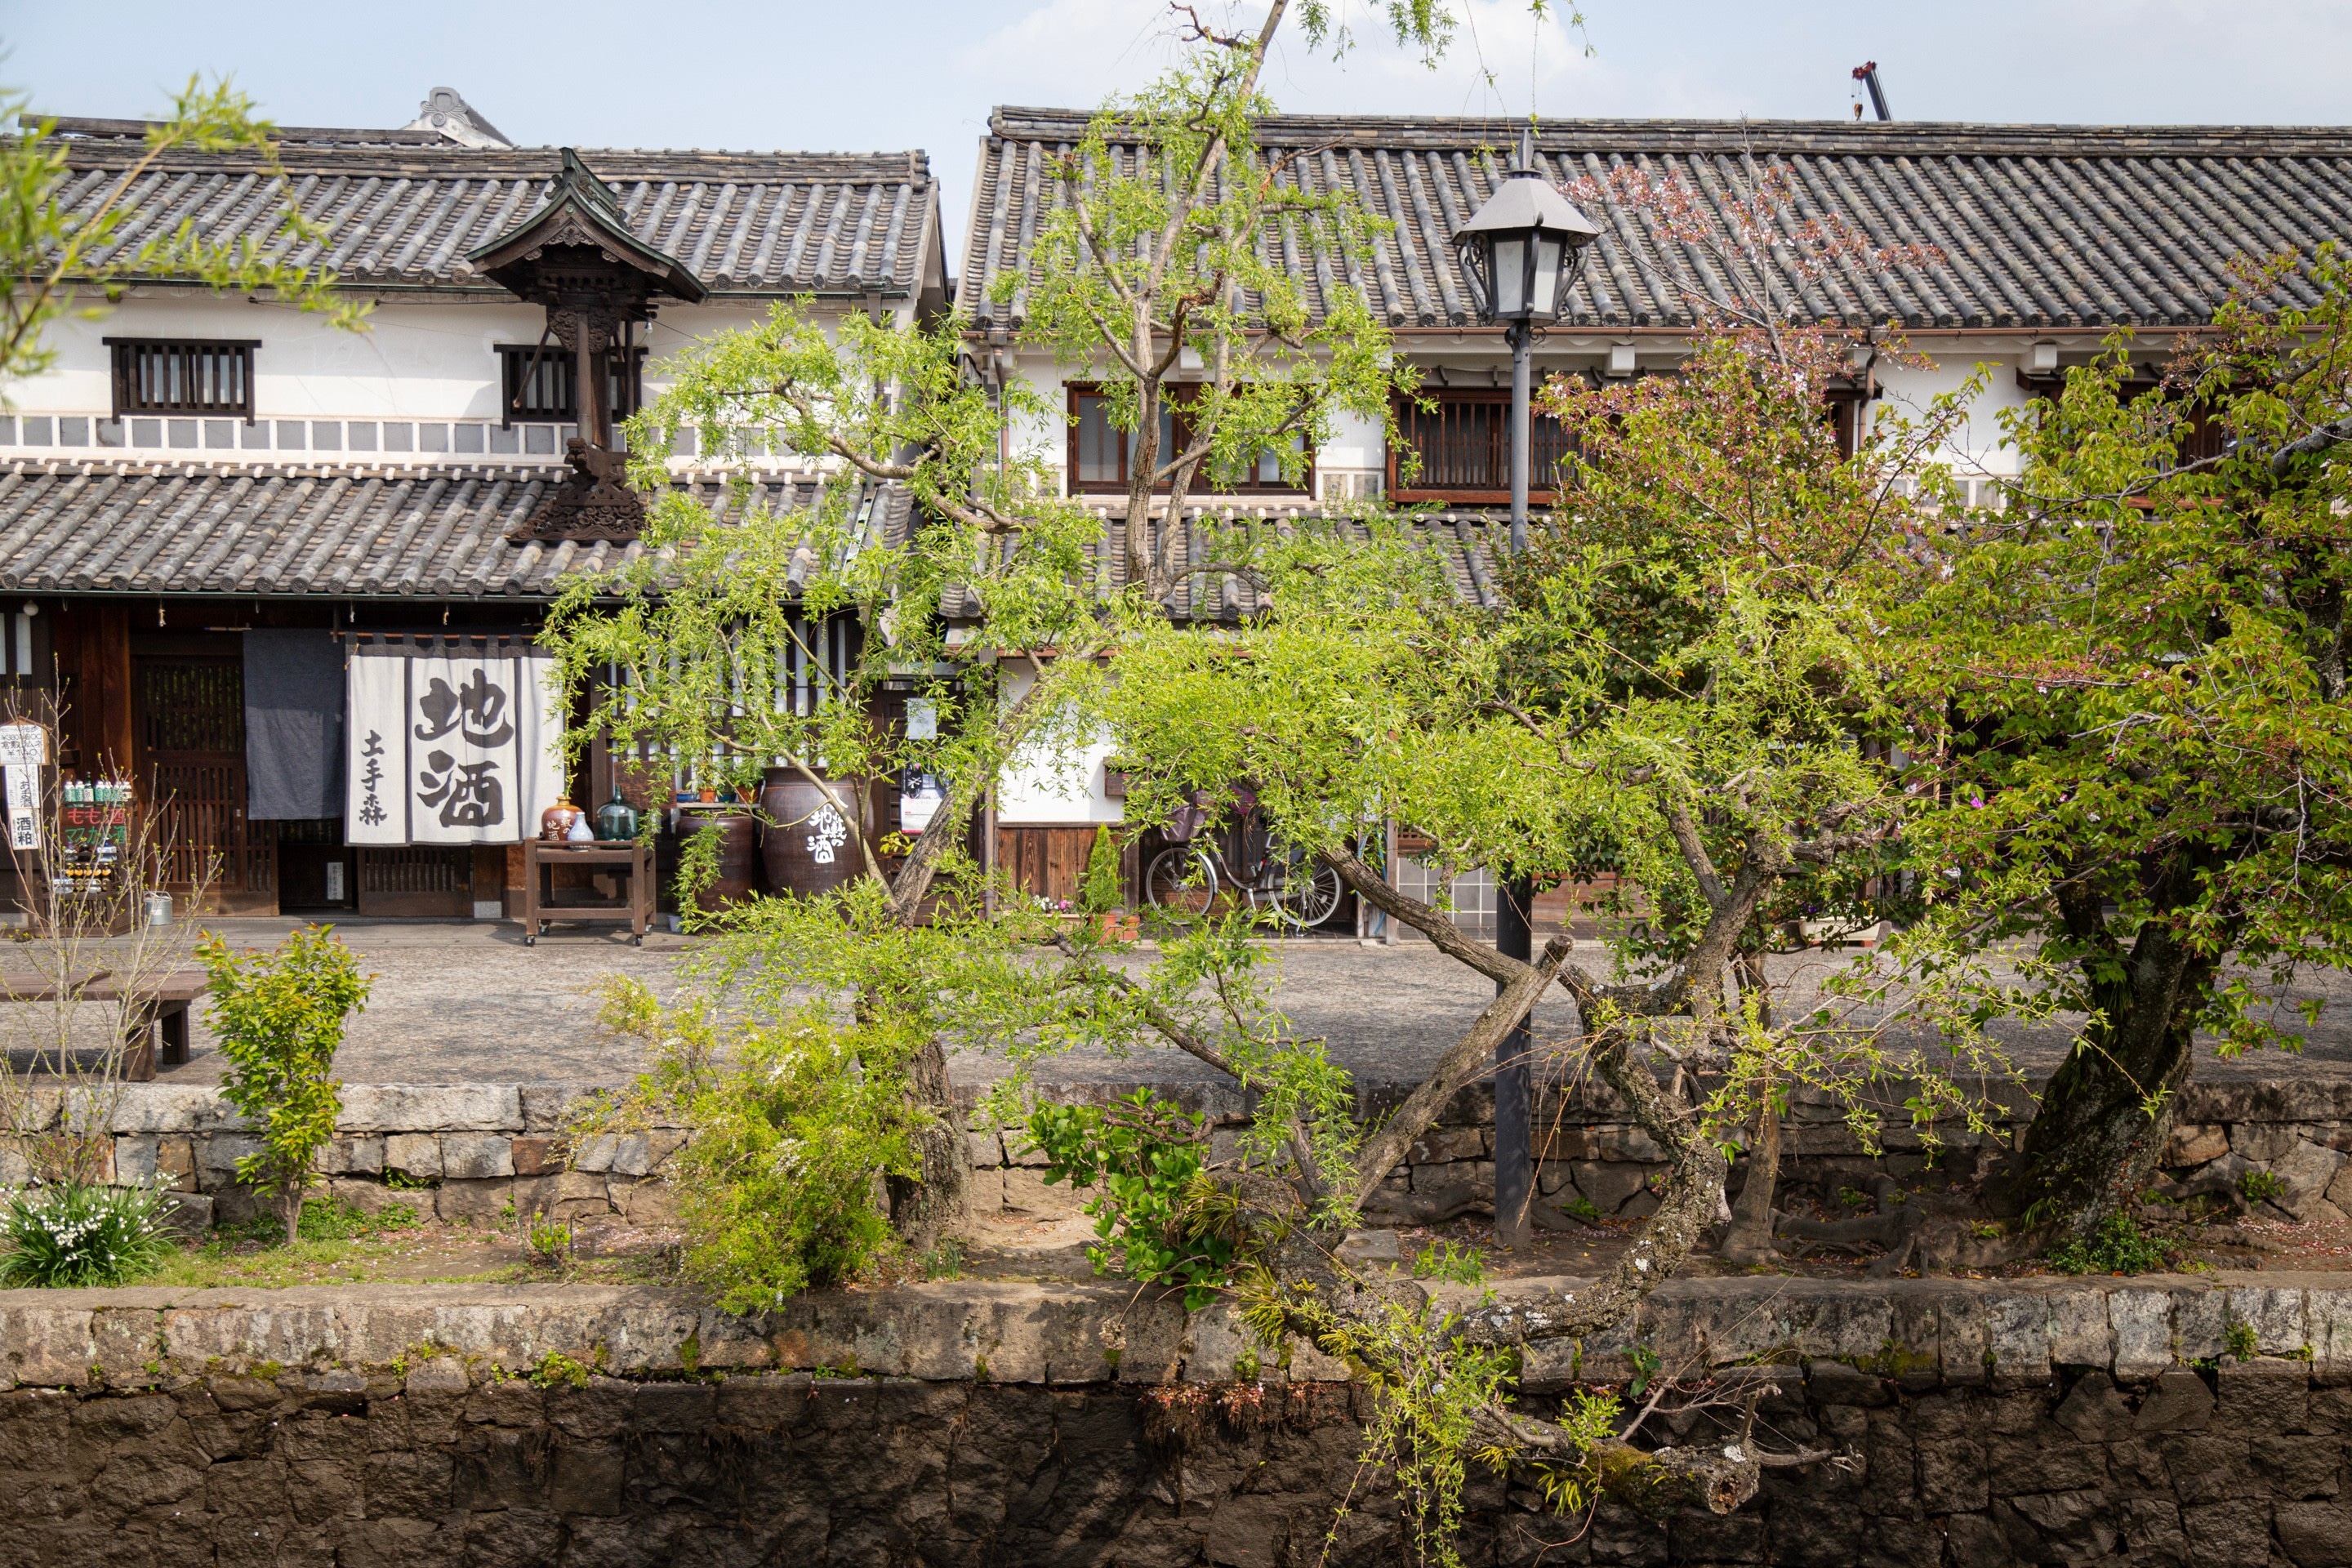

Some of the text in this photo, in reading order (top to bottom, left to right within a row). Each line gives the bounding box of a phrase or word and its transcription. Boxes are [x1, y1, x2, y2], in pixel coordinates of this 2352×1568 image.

[414, 667, 514, 827] 地酒
[359, 729, 388, 826] 土手森
[16, 817, 33, 845] 酒粕
[547, 820, 560, 841] 地酒
[807, 804, 835, 863] 地酒
